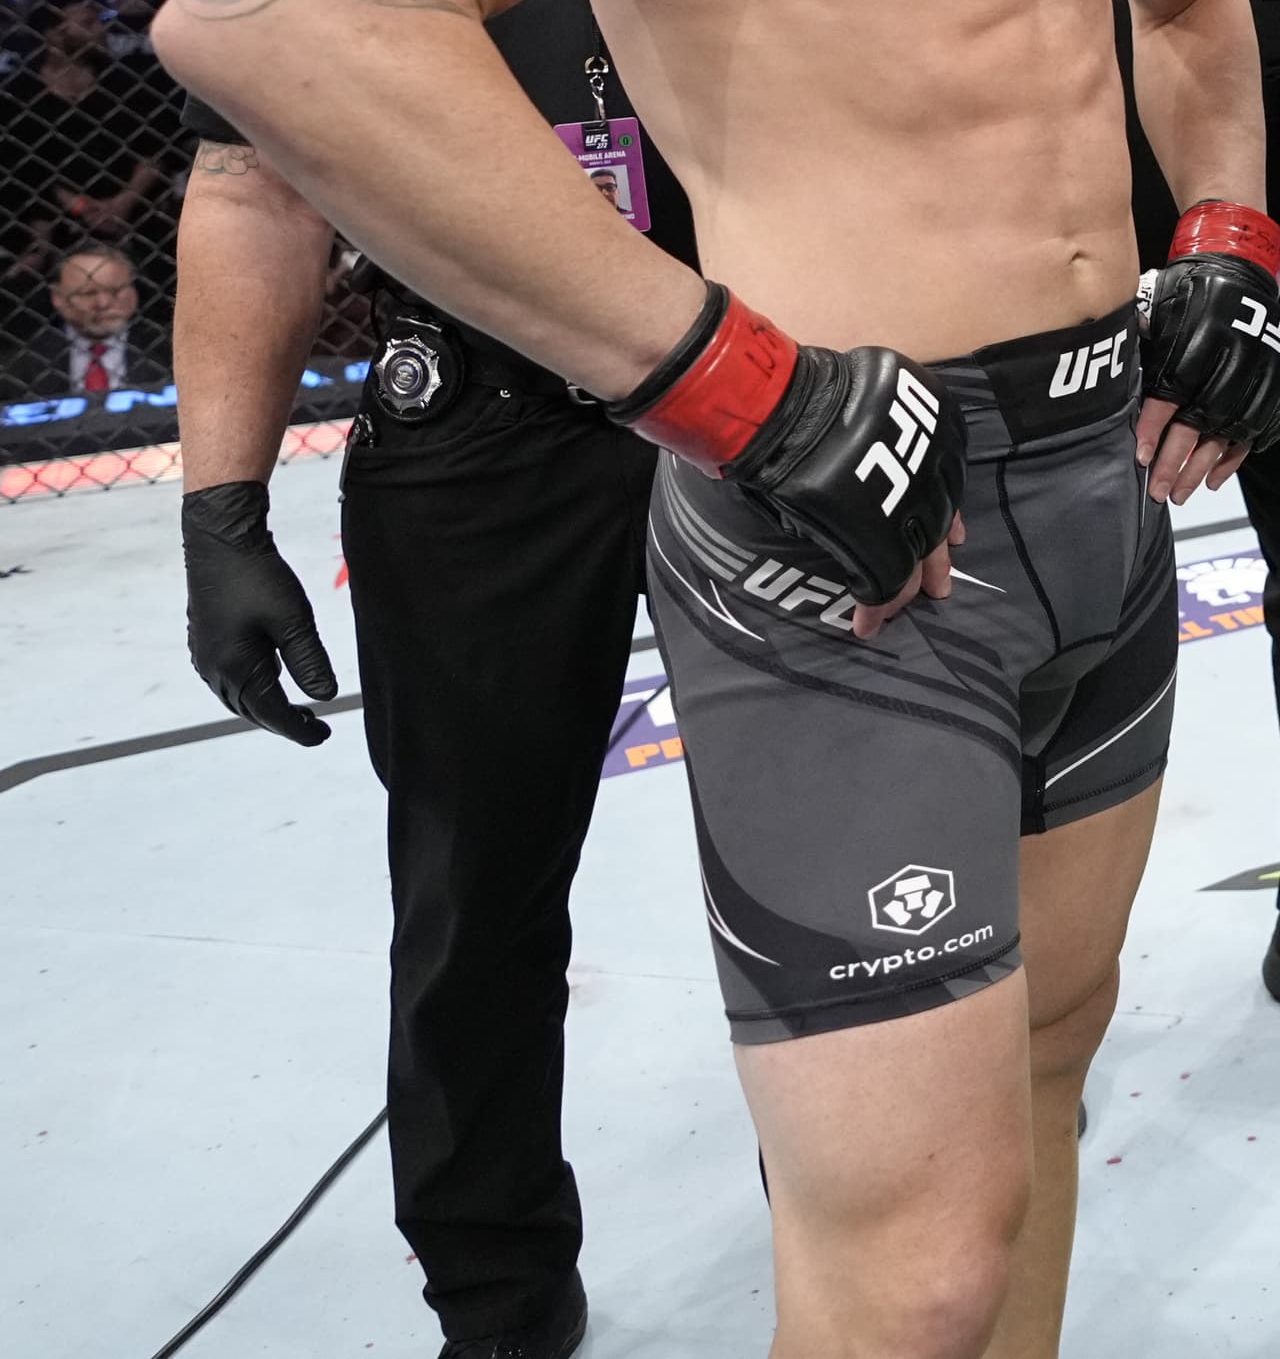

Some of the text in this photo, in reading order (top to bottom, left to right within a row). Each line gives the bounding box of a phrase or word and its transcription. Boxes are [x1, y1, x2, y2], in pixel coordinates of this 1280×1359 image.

[574, 150, 627, 162] -MOBILE ARENA
[585, 133, 609, 144] UFC
[1049, 328, 1127, 398] UFC
[854, 367, 940, 517] UFC
[829, 924, 994, 980] crypto.com
